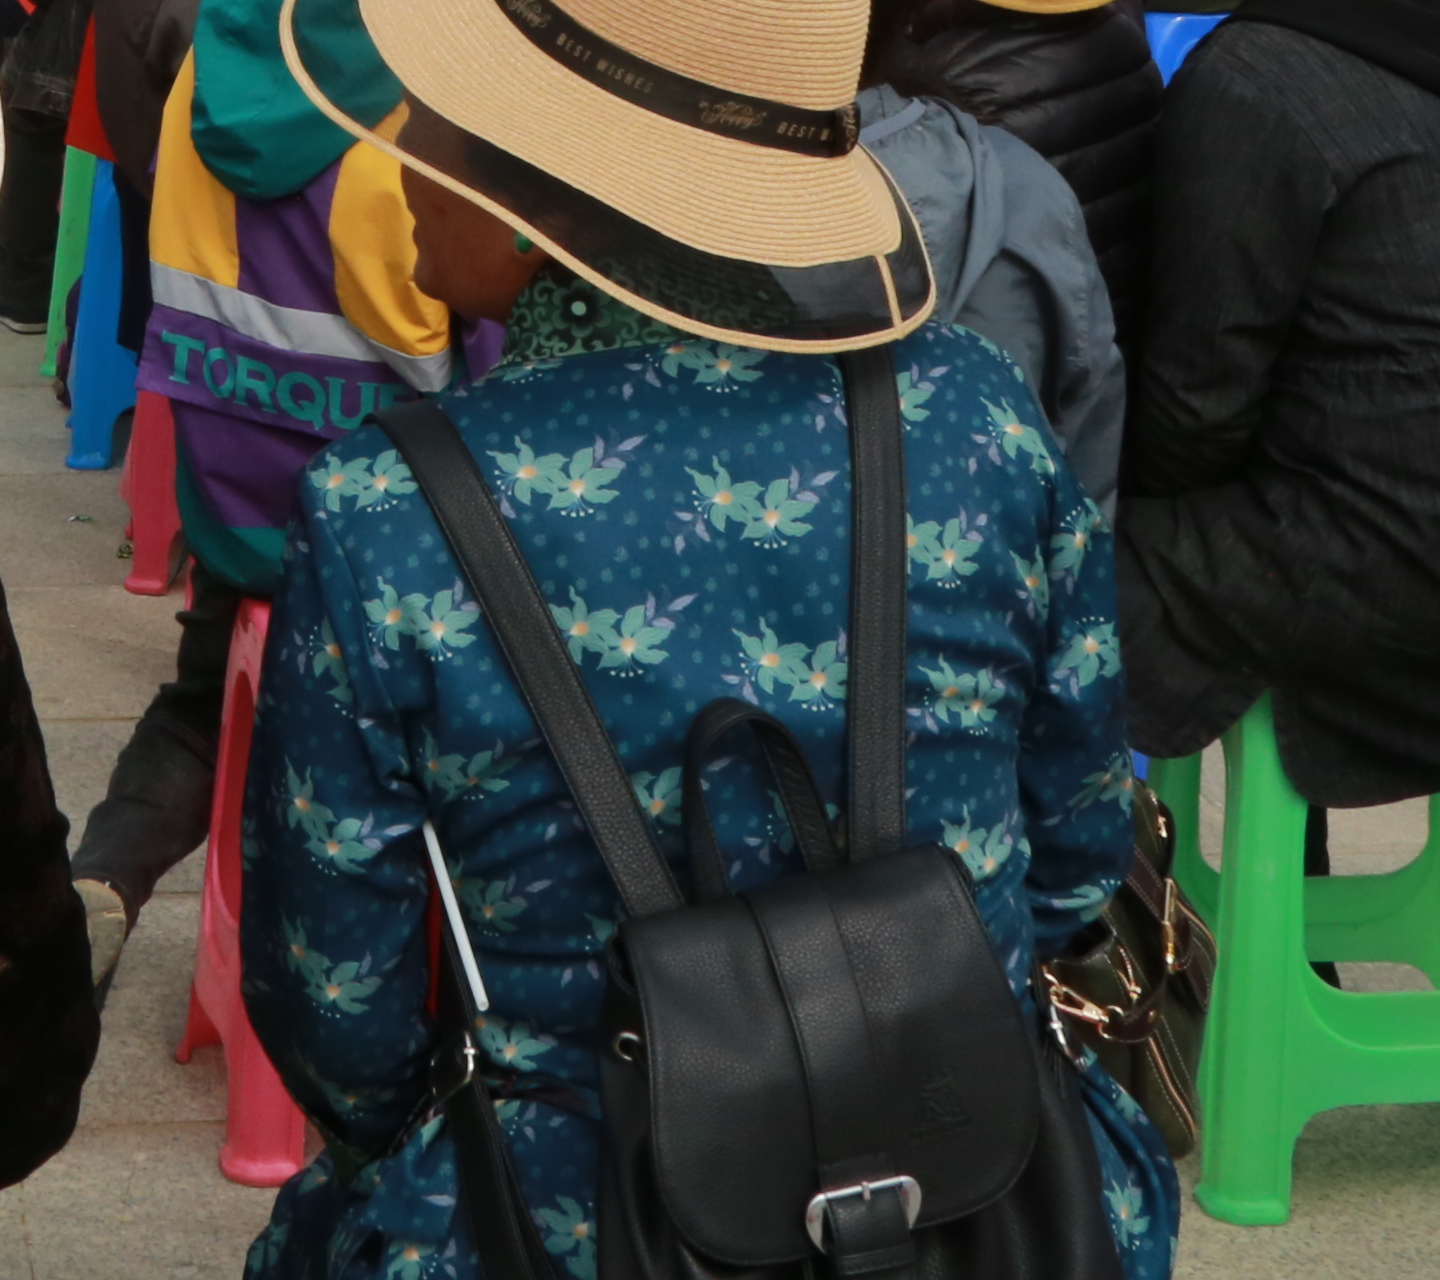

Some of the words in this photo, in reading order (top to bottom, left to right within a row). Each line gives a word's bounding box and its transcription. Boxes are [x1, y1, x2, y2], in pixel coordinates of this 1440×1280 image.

[555, 33, 593, 62] BEST
[595, 56, 655, 94] WISHES
[775, 120, 818, 141] BEST
